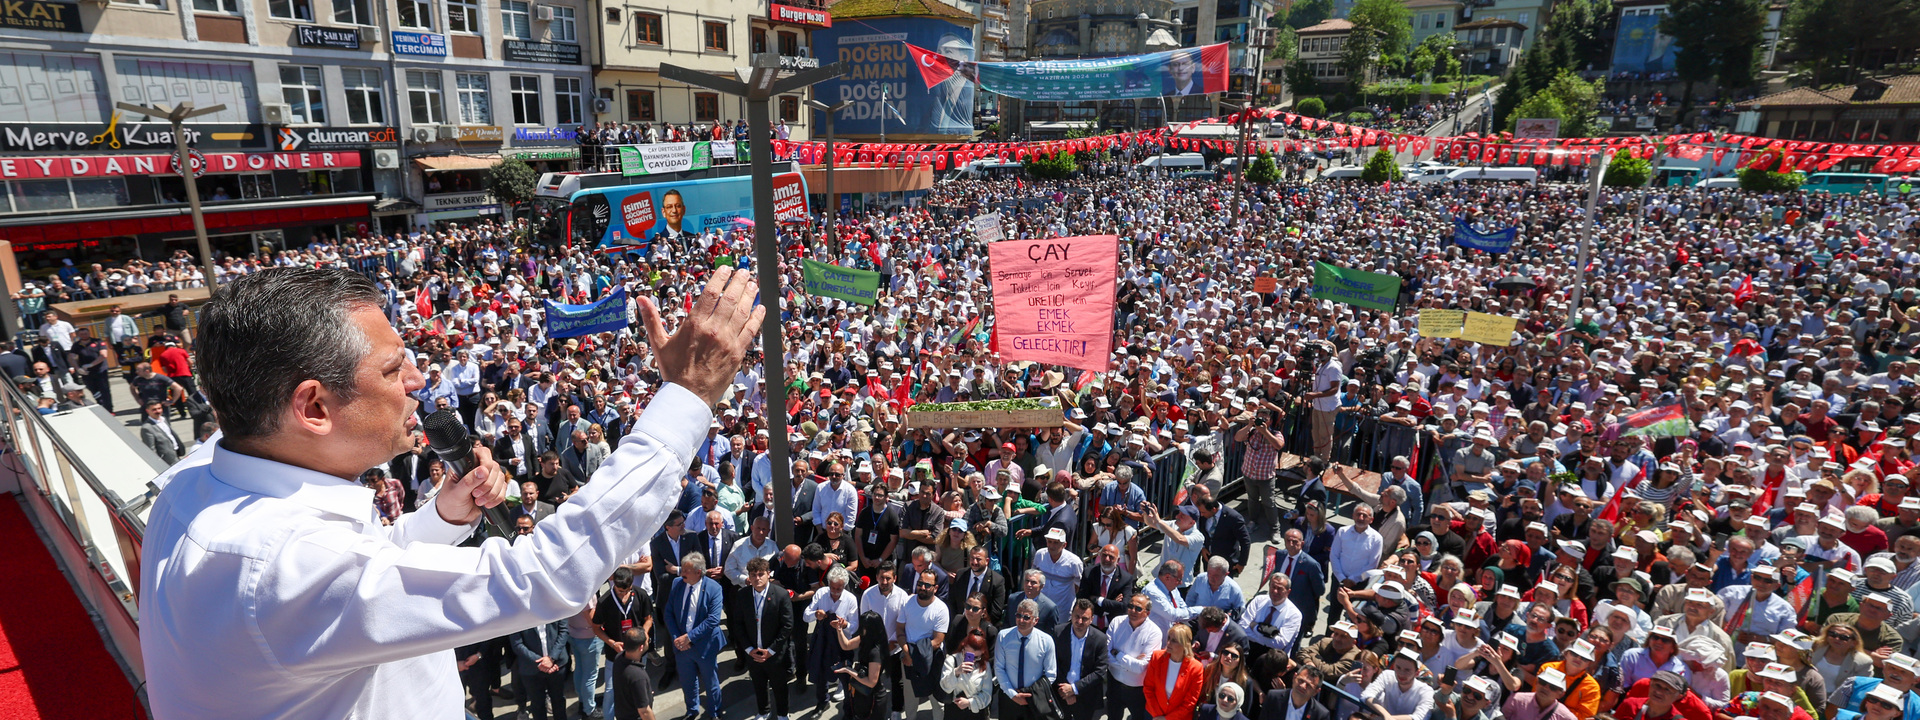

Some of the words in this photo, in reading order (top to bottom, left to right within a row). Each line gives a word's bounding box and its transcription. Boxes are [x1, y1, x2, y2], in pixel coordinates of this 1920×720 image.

[780, 7, 806, 22] Burger
[395, 34, 420, 43] YEMİNLİ
[396, 44, 446, 55] TERCÜMAN
[838, 43, 907, 63] DOĞRU
[840, 81, 907, 100] DOĞRU
[841, 100, 907, 120] ADAM
[5, 127, 90, 150] Merve
[307, 128, 397, 143] dumansoft
[659, 145, 686, 153] ÜRETİCİLERİ
[644, 152, 670, 160] DAYANIŞMA
[648, 160, 688, 169] ÇAYÜDAD
[435, 196, 462, 206] TEKNİK
[464, 195, 487, 204] SERVİS
[626, 207, 652, 220] GÜCÜMÜZ
[627, 214, 654, 226] TÜRKİYE
[704, 215, 726, 225] ÖZGÜR
[1028, 243, 1071, 264] ÇAY
[998, 270, 1032, 282] Sermaye
[820, 281, 874, 299] ÜRETİCİLERİ
[1312, 284, 1332, 294] ÇAY
[1332, 286, 1396, 306] ÜRETİCİLERİ
[1040, 308, 1071, 320] EMEK
[551, 320, 573, 332] ÇAY
[1037, 320, 1076, 333] EKMEK
